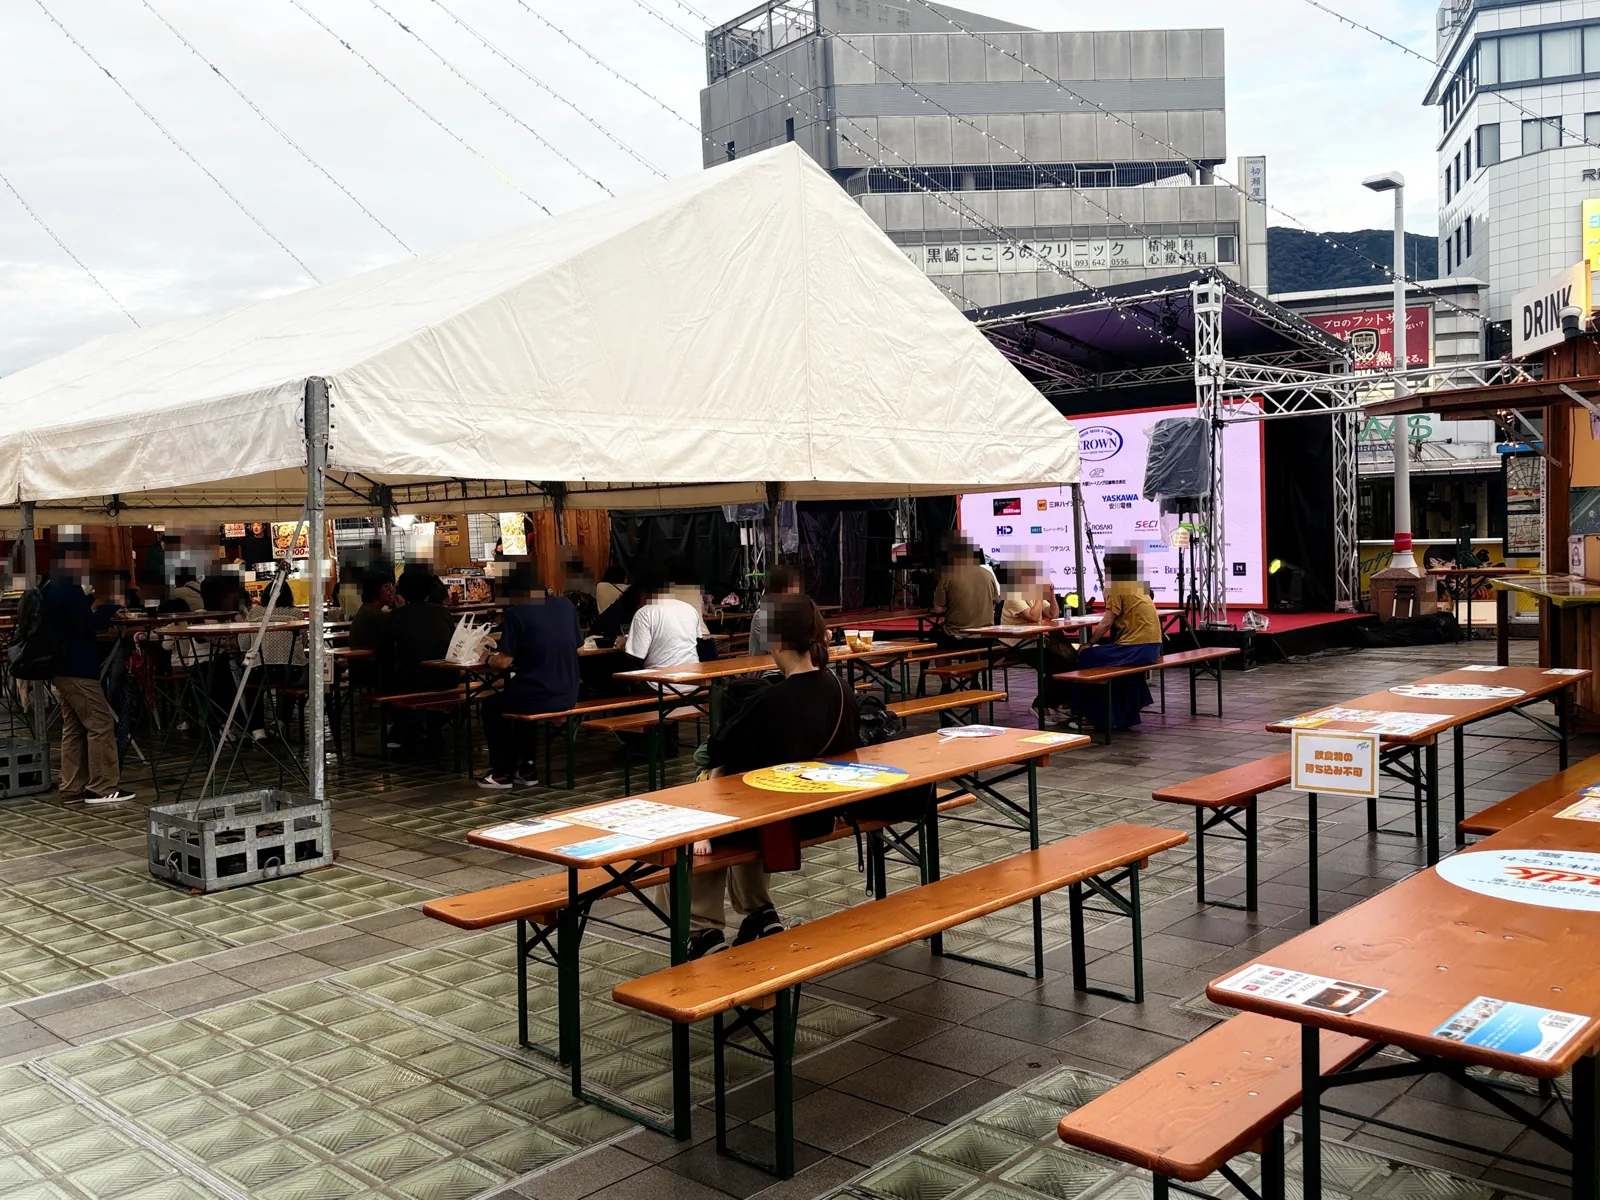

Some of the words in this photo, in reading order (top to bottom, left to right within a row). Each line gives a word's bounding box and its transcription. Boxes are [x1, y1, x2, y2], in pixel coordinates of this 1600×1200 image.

[1523, 284, 1573, 342] DRINK
[1101, 493, 1139, 503] YASKAWA
[1314, 750, 1353, 762] 飲食物の
[1305, 763, 1363, 777] 持ち込み不可
